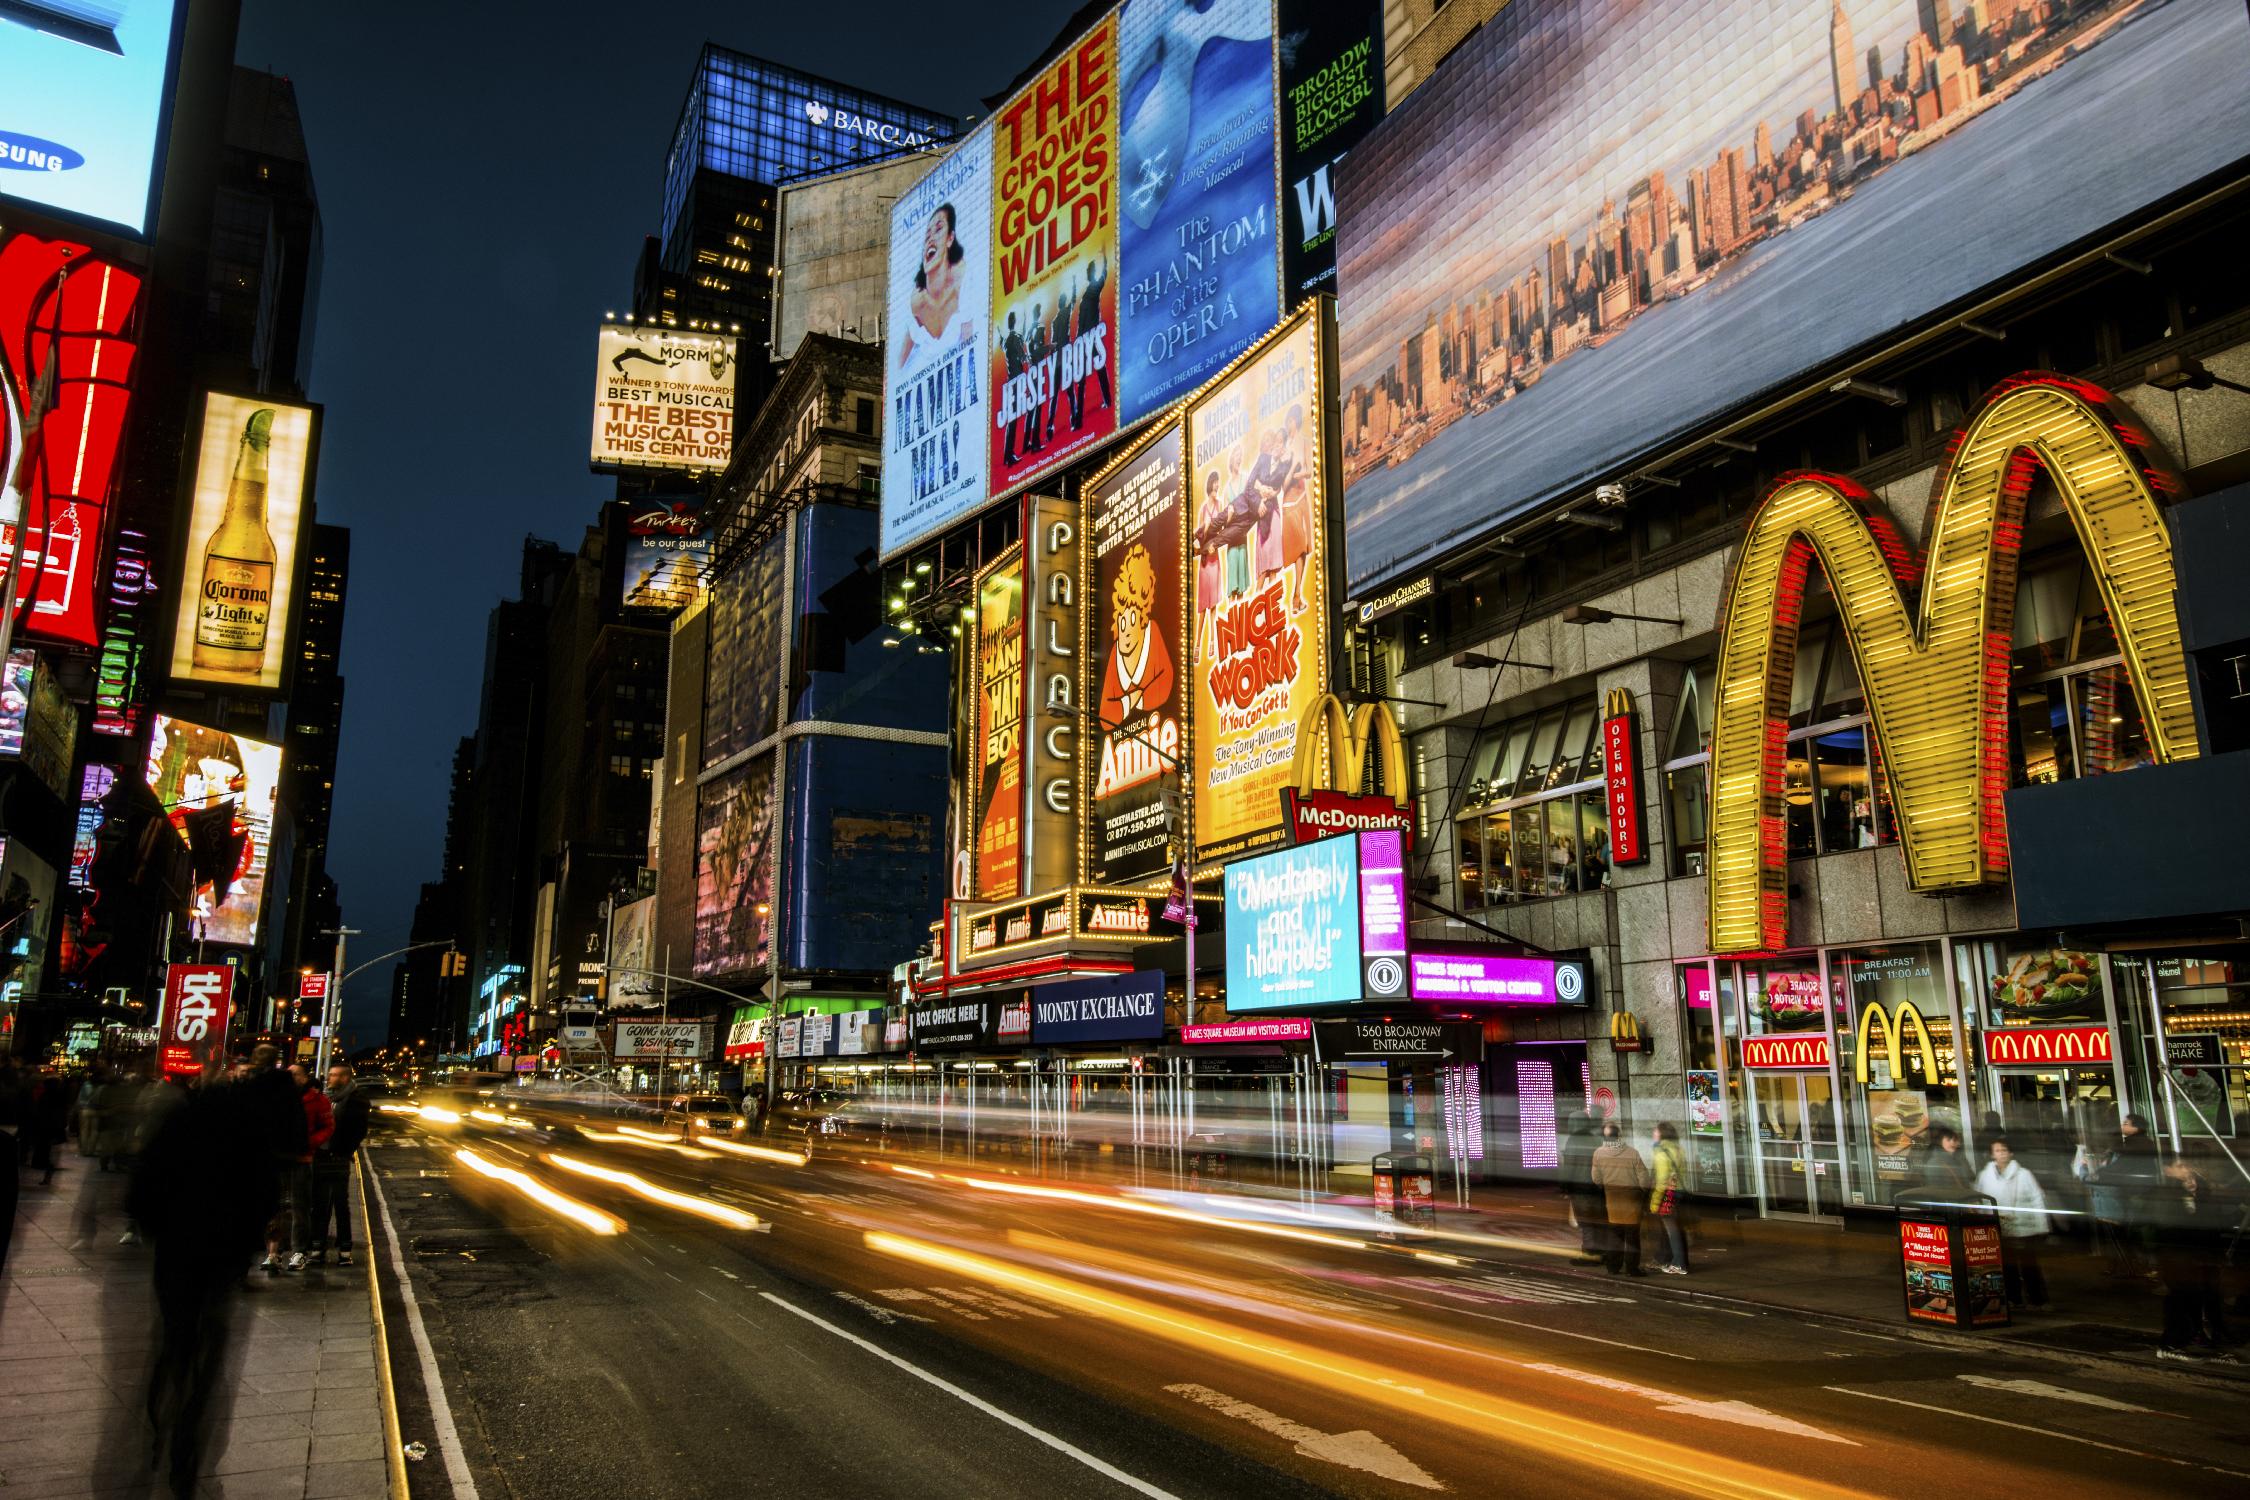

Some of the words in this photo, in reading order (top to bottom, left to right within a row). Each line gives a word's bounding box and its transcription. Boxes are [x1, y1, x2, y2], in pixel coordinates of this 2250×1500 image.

[1289, 36, 1373, 104] "BROADW
[1296, 59, 1368, 124] BIGGEST
[833, 110, 939, 152] BARCLAY
[1310, 132, 1324, 145] New
[1325, 121, 1338, 136] York
[1338, 111, 1356, 126] Times
[1001, 94, 1109, 202] CROWD
[1181, 115, 1269, 187] Longest-Running
[919, 174, 940, 201] THE
[940, 151, 964, 181] FUN
[1203, 151, 1245, 192] Musical
[902, 193, 937, 233] NEVER
[939, 156, 979, 201] STOPS!
[1000, 133, 1108, 247] GOES
[1176, 216, 1210, 247] The
[1302, 237, 1318, 253] THE
[1129, 204, 1267, 319] PHANTOM
[1171, 285, 1190, 317] of
[1191, 275, 1218, 306] the
[1148, 292, 1239, 365] OPERA
[997, 352, 1058, 429] JERSEY
[1061, 322, 1107, 391] BOYS
[1144, 380, 1173, 403] MAJESTIC
[1173, 360, 1205, 387] THEATRE,
[1205, 355, 1217, 369] 247
[1218, 348, 1229, 361] W.
[1228, 337, 1247, 354] 44TH
[608, 387, 652, 402] BEST
[657, 391, 735, 410] MUSICAL
[609, 377, 651, 388] WINNER
[654, 381, 661, 389] 9
[664, 382, 692, 391] TONY
[693, 384, 735, 395] AWARDS
[894, 348, 979, 454] MAMMA
[604, 422, 699, 443] MUSICAL
[703, 430, 734, 447] OF
[666, 407, 734, 431] BEST
[604, 438, 645, 453] THIS
[648, 442, 731, 460] CENTURY
[909, 419, 960, 506] MIA!
[1123, 457, 1161, 496] ULTIMATE
[892, 517, 900, 528] THE
[901, 510, 916, 523] SMASH
[925, 493, 944, 509] MUSICAL
[1095, 491, 1137, 532] FEEL-GOOD
[1139, 461, 1176, 499] MUSICAL
[1108, 520, 1116, 535] IS
[1118, 503, 1139, 528] BACK
[1141, 488, 1160, 512] AND
[632, 510, 698, 535] Turkey
[1097, 530, 1123, 558] BETTER
[1124, 512, 1147, 538] THAN
[642, 536, 656, 548] be
[658, 540, 677, 549] our
[678, 537, 706, 550] guest
[205, 579, 268, 604] Corona
[1395, 587, 1431, 607] SPECTACOLOR
[214, 603, 252, 622] Light
[1215, 577, 1287, 664] NICE
[1045, 520, 1074, 814] PALACE
[1208, 627, 1300, 709] WORK
[1220, 712, 1229, 734] If
[1228, 712, 1245, 731] You
[1245, 706, 1263, 728] Can
[1262, 692, 1280, 714] Get
[1280, 690, 1288, 709] It
[1113, 729, 1124, 741] THE
[1124, 717, 1147, 736] MUSICAL
[1215, 746, 1232, 762] The
[1233, 722, 1297, 754] Tony-Winning
[1096, 712, 1179, 799] Annie
[1610, 724, 1624, 773] OPEN
[1208, 768, 1228, 788] New
[1228, 752, 1264, 780] Musical
[1612, 776, 1627, 789] 24
[1106, 832, 1115, 842] OR
[1115, 813, 1165, 839] 877-250-2929
[1299, 806, 1411, 833] McDonald's
[1615, 792, 1628, 854] HOURS
[1104, 833, 1168, 862] ANNIETHEMUSICAL.COM
[1005, 915, 1031, 943] Annie
[1088, 903, 1149, 932] Annie
[974, 924, 997, 951] Annie
[1415, 961, 1446, 976] TIMES
[1447, 963, 1485, 977] SQUARE
[1853, 971, 1882, 983] UNTIL
[1886, 968, 1912, 979] 11:00
[1914, 967, 1932, 977] AM
[1864, 957, 1916, 970] BREAKFAST
[1416, 978, 1460, 992] MUSEUM
[1461, 979, 1470, 992] &
[1471, 980, 1507, 994] VISITOR
[1508, 982, 1542, 995] CENTER
[177, 971, 222, 1041] tkts
[916, 1010, 931, 1027] BOX
[932, 1007, 956, 1024] OFFICE
[958, 1004, 979, 1022] HERE
[998, 1003, 1030, 1035] Annie
[1037, 1000, 1079, 1024] MONEY
[1081, 993, 1155, 1019] EXCHANGE
[627, 1025, 658, 1036] GOING
[660, 1026, 680, 1036] OUT
[680, 1026, 697, 1036] OF
[633, 1037, 676, 1048] BUSINE
[884, 1018, 907, 1044] Annie
[1189, 1029, 1203, 1038] TIMES
[1203, 1027, 1222, 1039] SQUARE
[1223, 1026, 1245, 1037] MUSEUM
[1246, 1026, 1257, 1036] AND
[1258, 1024, 1280, 1035] VISITOR
[1280, 1023, 1302, 1034] CENTER
[1356, 1025, 1382, 1038] 1560
[1384, 1025, 1442, 1038] BROADWAY
[1373, 1038, 1427, 1051] ENTRANCE
[1915, 1231, 1934, 1240] SQUARE
